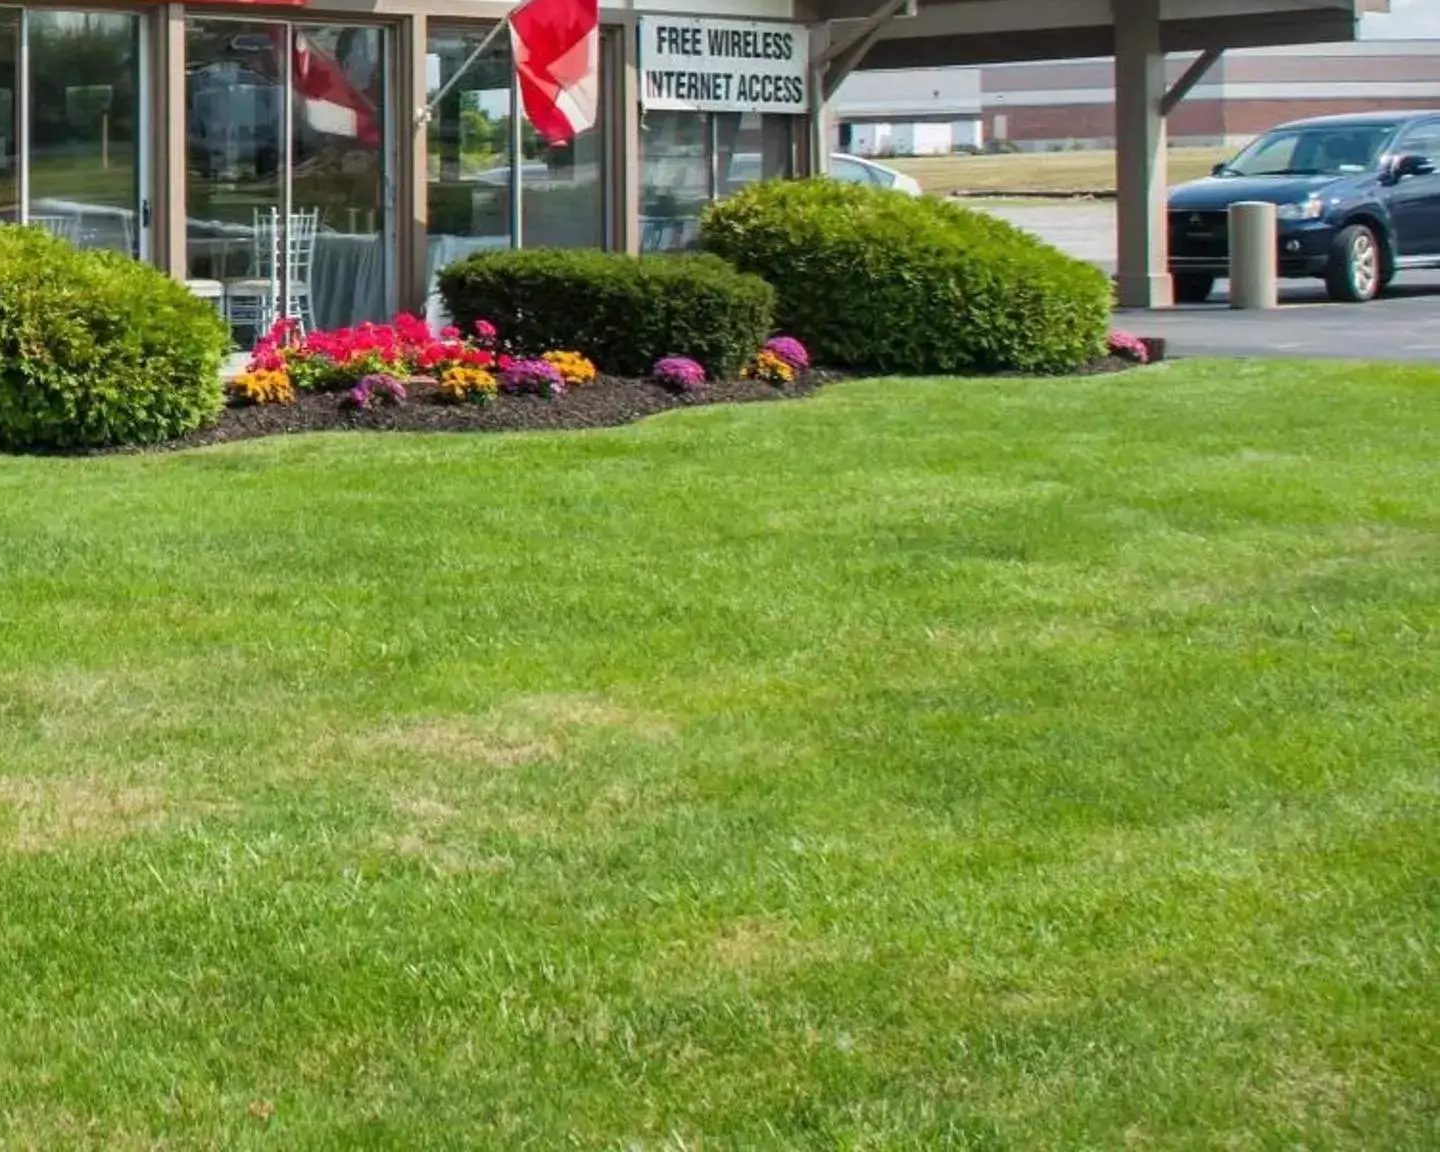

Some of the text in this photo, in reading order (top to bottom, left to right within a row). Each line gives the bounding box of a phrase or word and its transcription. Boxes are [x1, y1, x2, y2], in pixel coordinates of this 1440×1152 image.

[656, 26, 793, 60] FREE WIRELESS
[646, 70, 803, 103] INTERNET ACCESS
